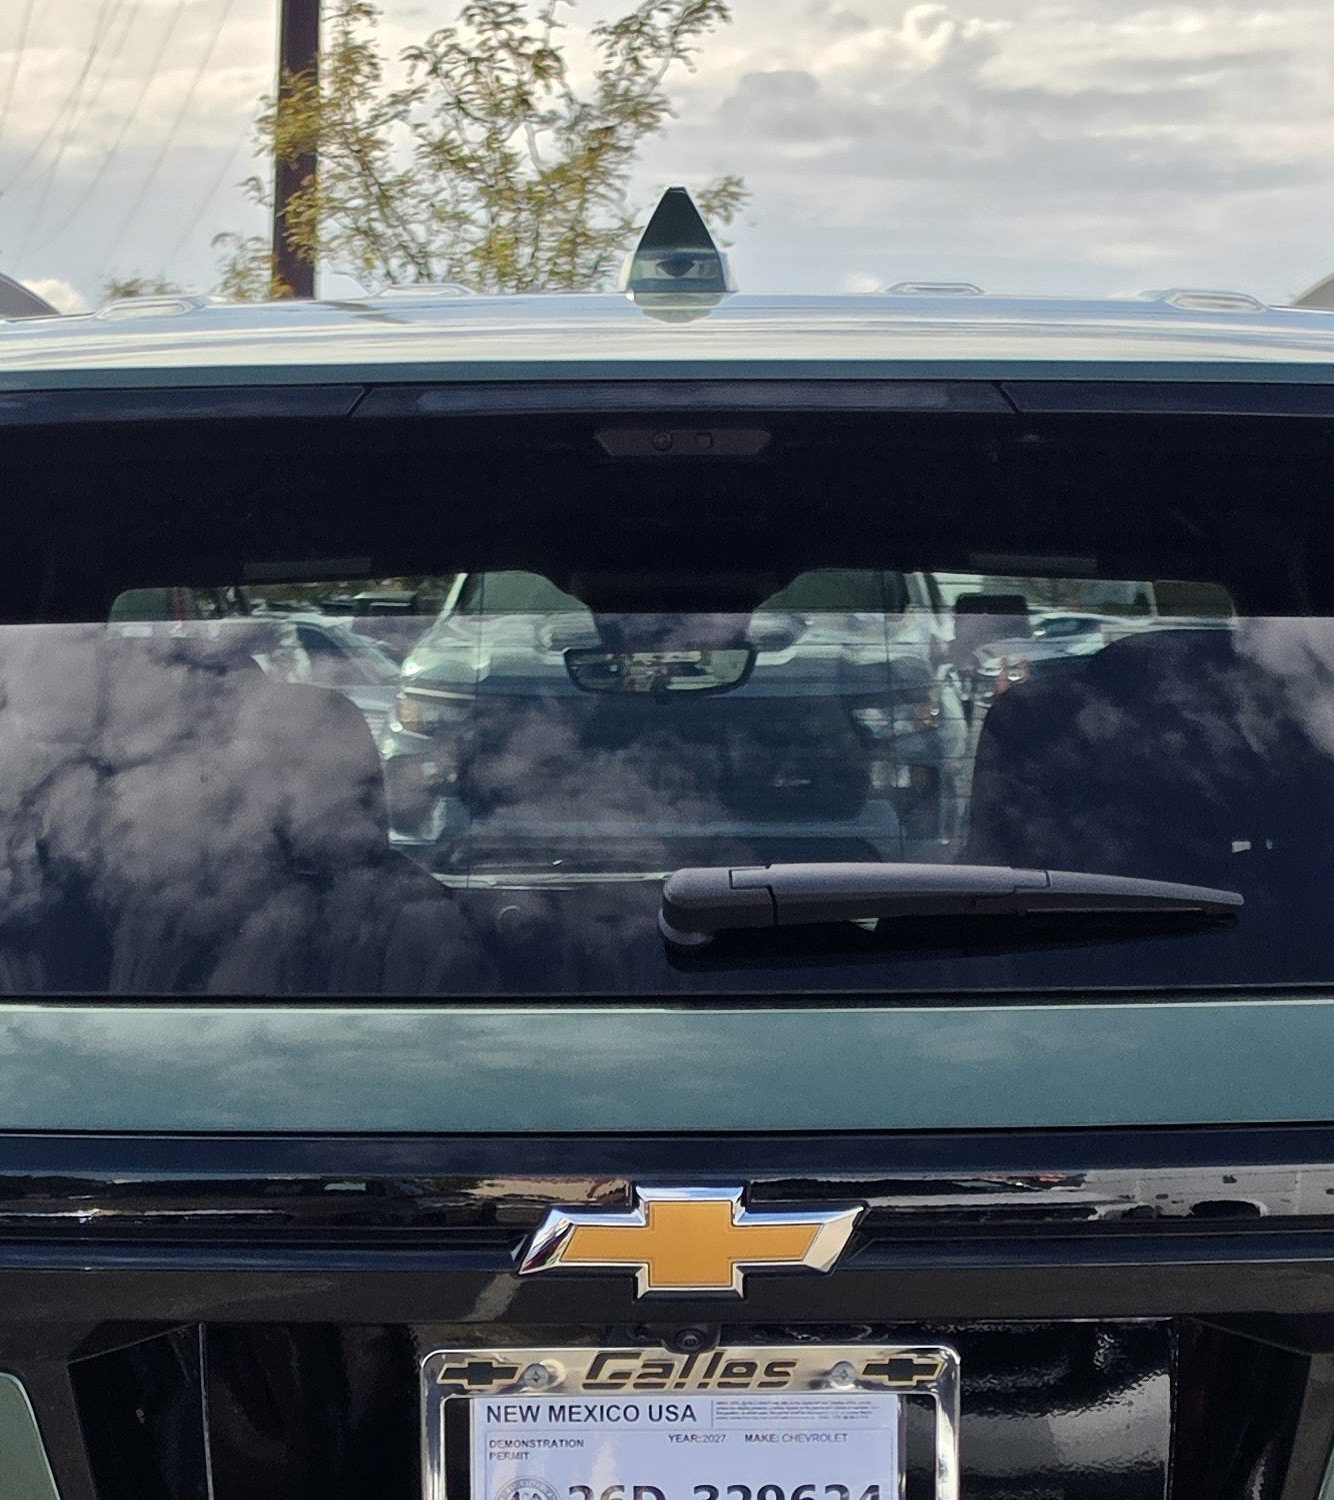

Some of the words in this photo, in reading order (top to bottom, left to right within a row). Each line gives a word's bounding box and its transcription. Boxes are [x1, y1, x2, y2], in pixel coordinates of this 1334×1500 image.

[582, 1351, 798, 1390] Galles
[487, 1405, 540, 1423] NEW
[548, 1405, 640, 1423] MEXICO
[648, 1404, 697, 1423] USA
[489, 1438, 584, 1448] DEMONSTRATION
[781, 1433, 848, 1443] CHEVROLET
[489, 1451, 529, 1461] PERMIT
